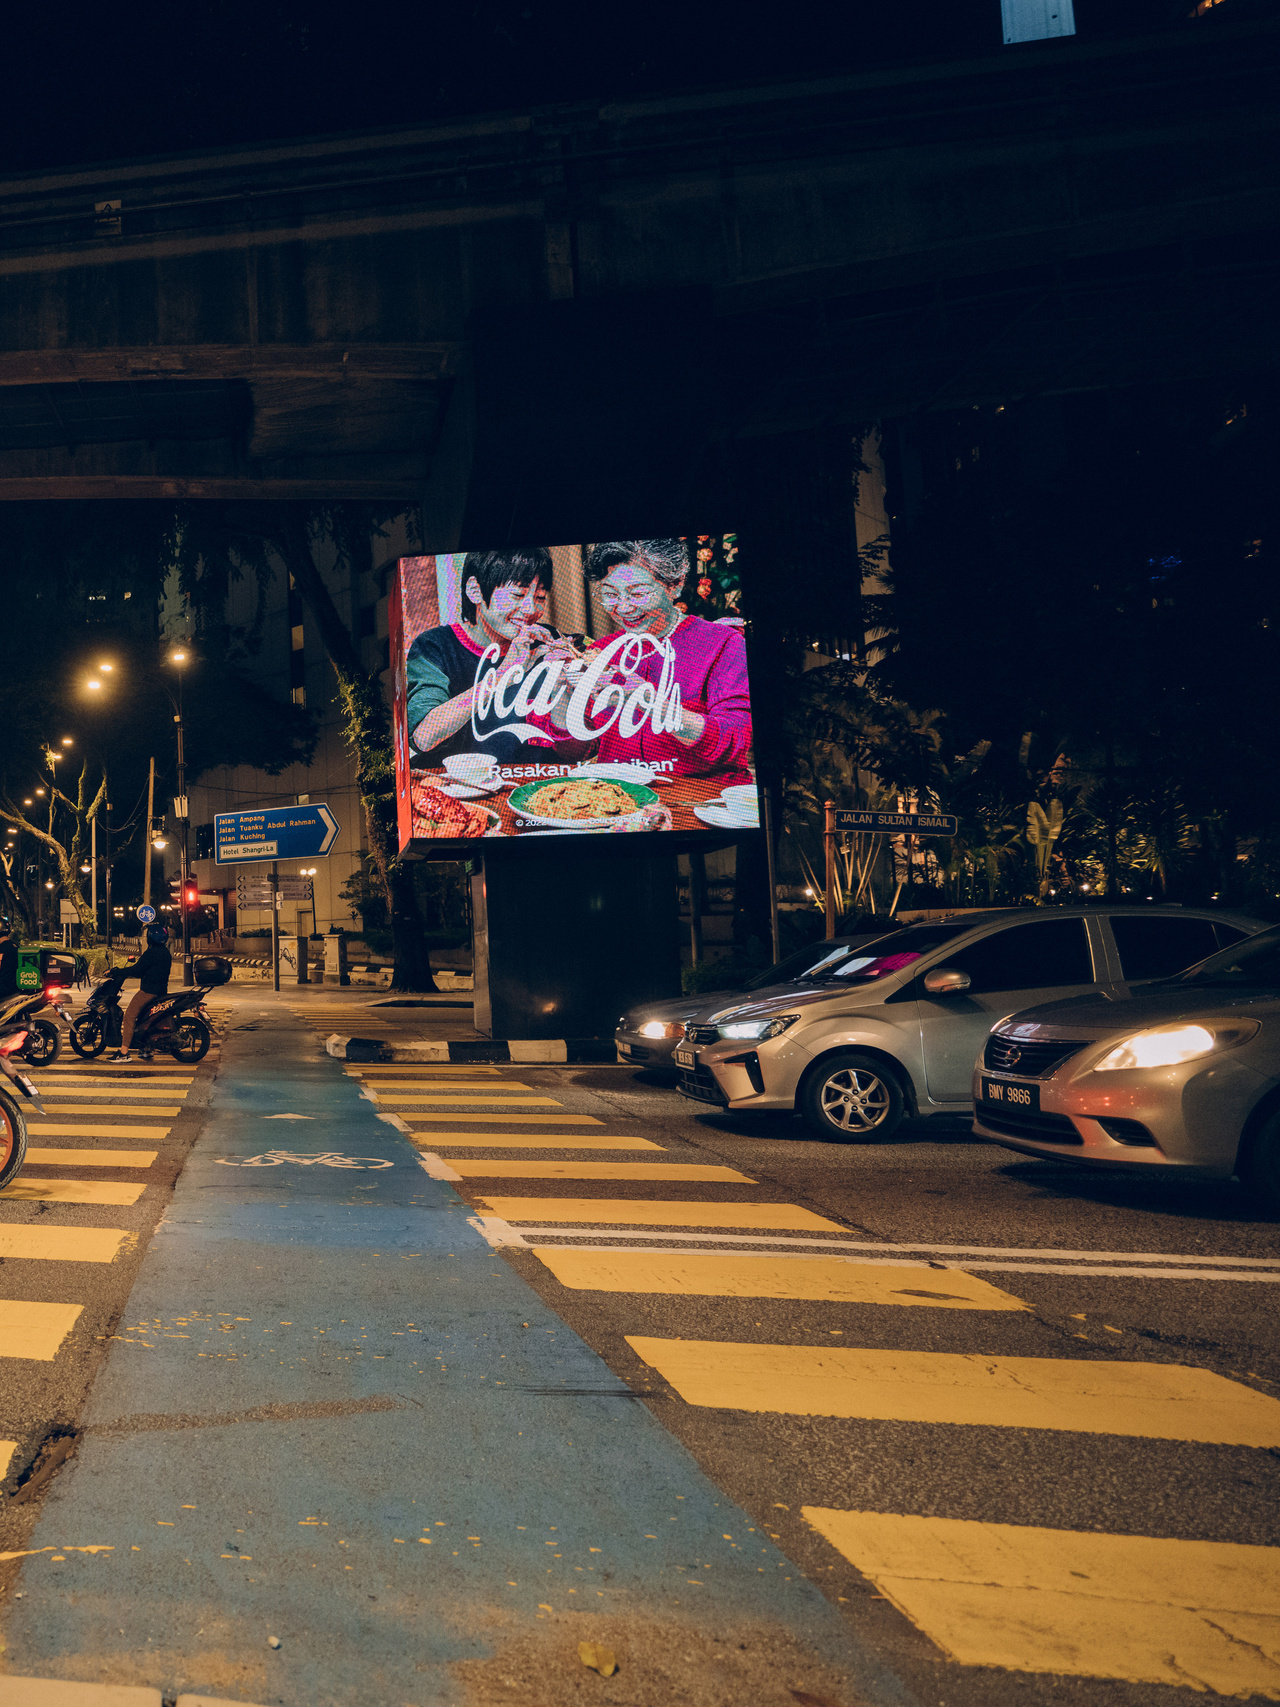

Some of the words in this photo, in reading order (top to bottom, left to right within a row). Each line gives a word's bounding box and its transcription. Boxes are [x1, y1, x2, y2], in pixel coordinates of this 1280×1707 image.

[471, 633, 684, 743] Coca-Cola
[490, 763, 571, 779] Rasakan
[219, 818, 236, 826] Jalan
[239, 815, 265, 824] Ampang
[239, 824, 264, 832] Tuanku
[267, 821, 286, 829] Abdul
[289, 819, 316, 827] Rahman
[840, 813, 873, 824] JALAN
[877, 815, 913, 826] SULTAN
[917, 817, 951, 828] ISMAIL
[219, 835, 236, 843] Jalan
[239, 832, 266, 841] Kuching
[223, 848, 239, 856] Hotel
[242, 845, 274, 855] Shangri-La
[20, 971, 38, 979] Grab
[20, 978, 38, 986] Food
[988, 1083, 1004, 1101] BMY
[1006, 1086, 1031, 1105] 9866
